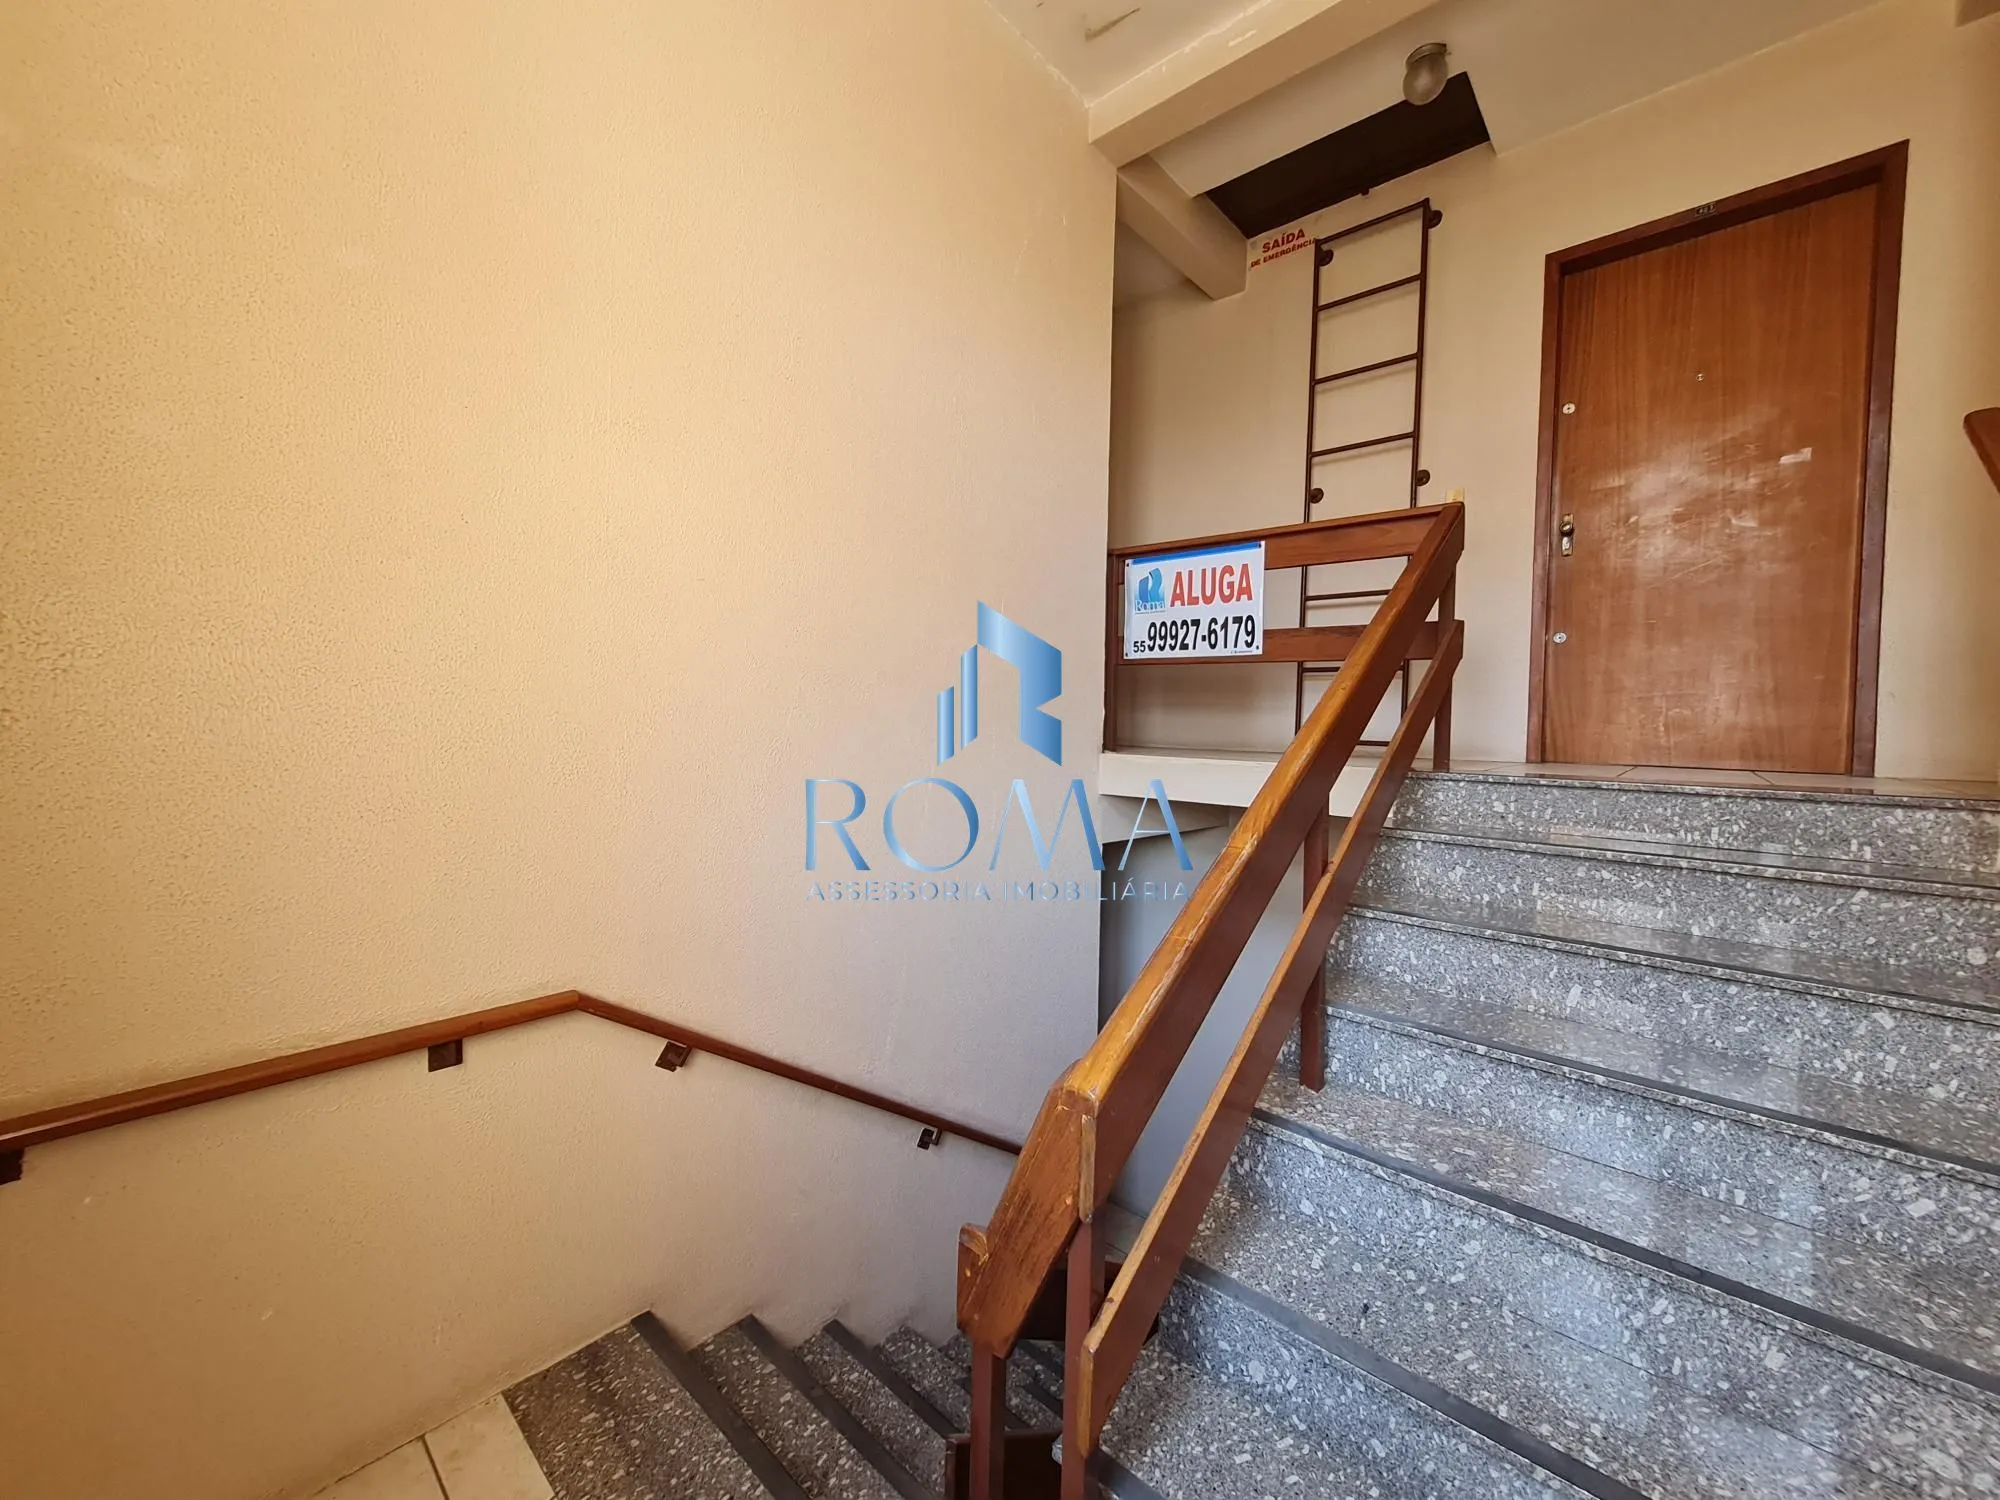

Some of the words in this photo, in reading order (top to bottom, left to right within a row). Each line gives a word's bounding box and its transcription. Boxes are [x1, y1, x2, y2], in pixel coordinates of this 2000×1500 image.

[1262, 228, 1305, 253] SAÍDA
[1250, 258, 1261, 268] DE
[1170, 563, 1253, 608] ALUGA
[1133, 640, 1146, 653] 55
[1147, 615, 1256, 653] 99927-6179
